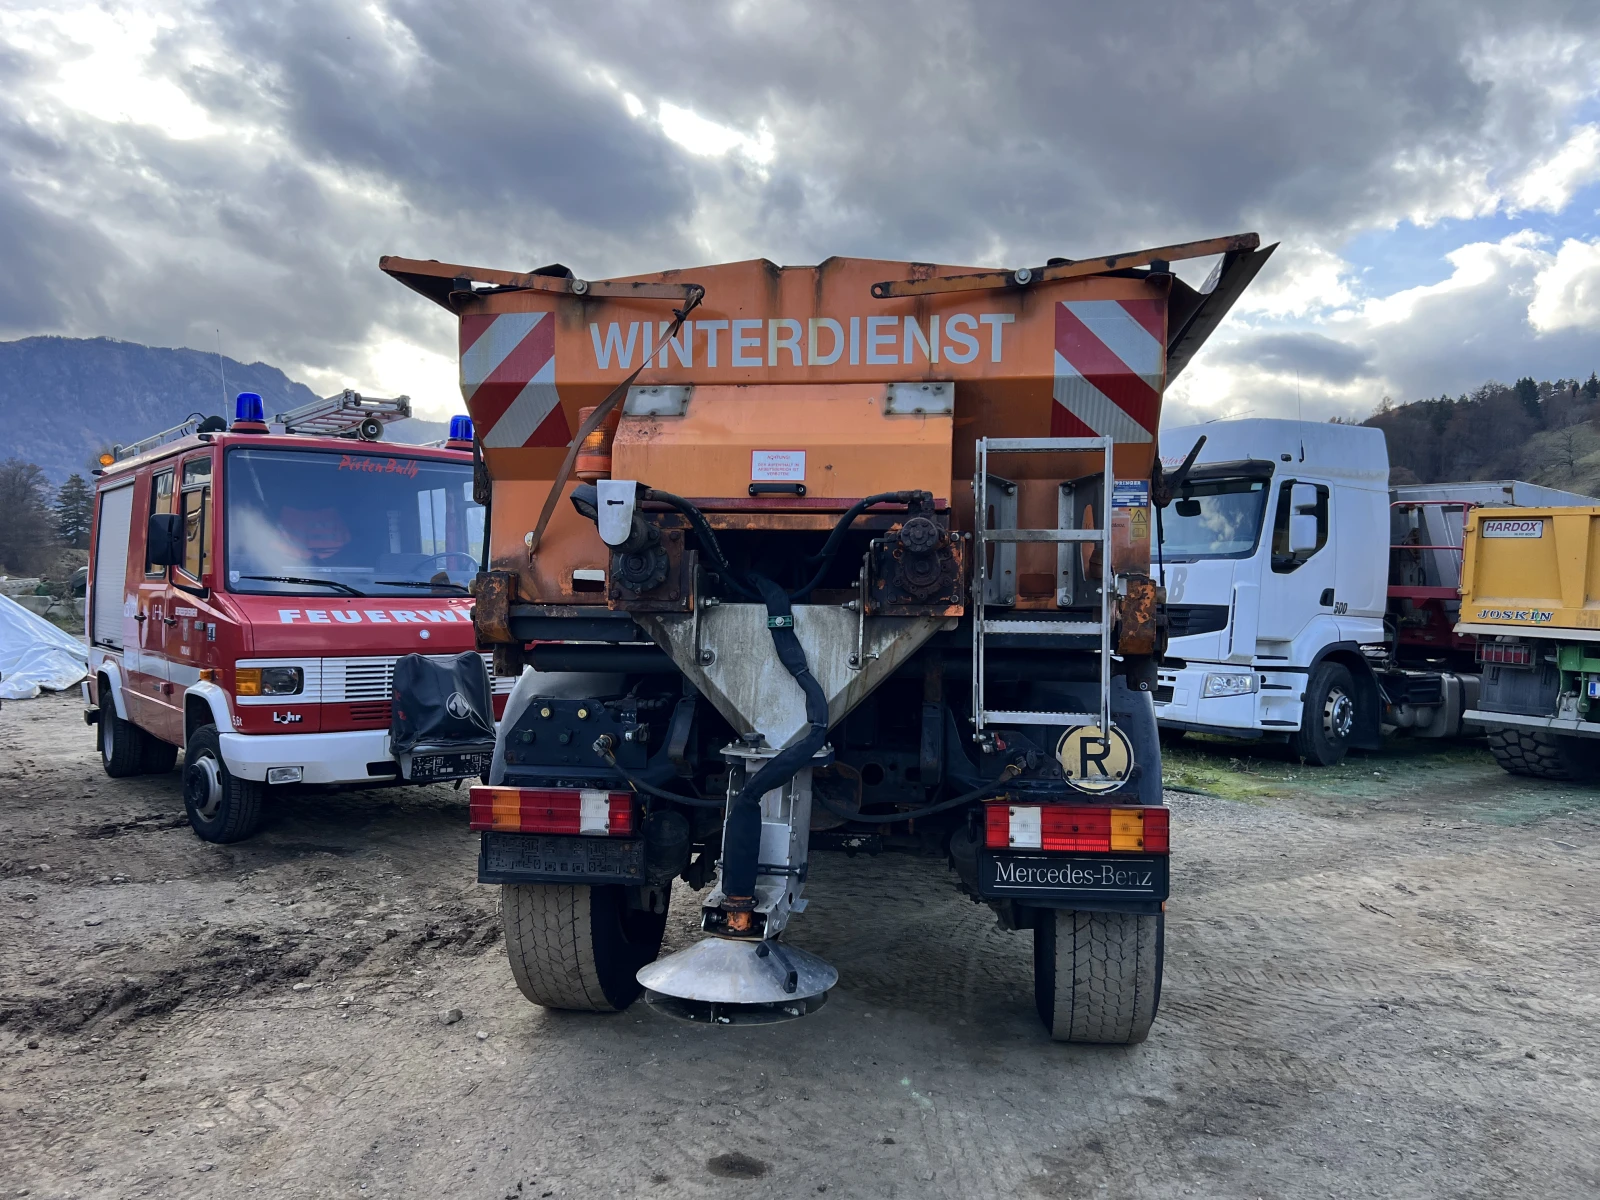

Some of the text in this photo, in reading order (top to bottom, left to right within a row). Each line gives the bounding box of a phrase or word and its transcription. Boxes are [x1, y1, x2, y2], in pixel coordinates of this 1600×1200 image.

[589, 313, 1015, 369] WINTERDIENST
[1333, 601, 1348, 615] 500
[1477, 609, 1554, 622] JOSKIN
[273, 711, 302, 725] Lohr
[1080, 736, 1111, 779] R
[994, 861, 1153, 886] Mercedes-Benz
